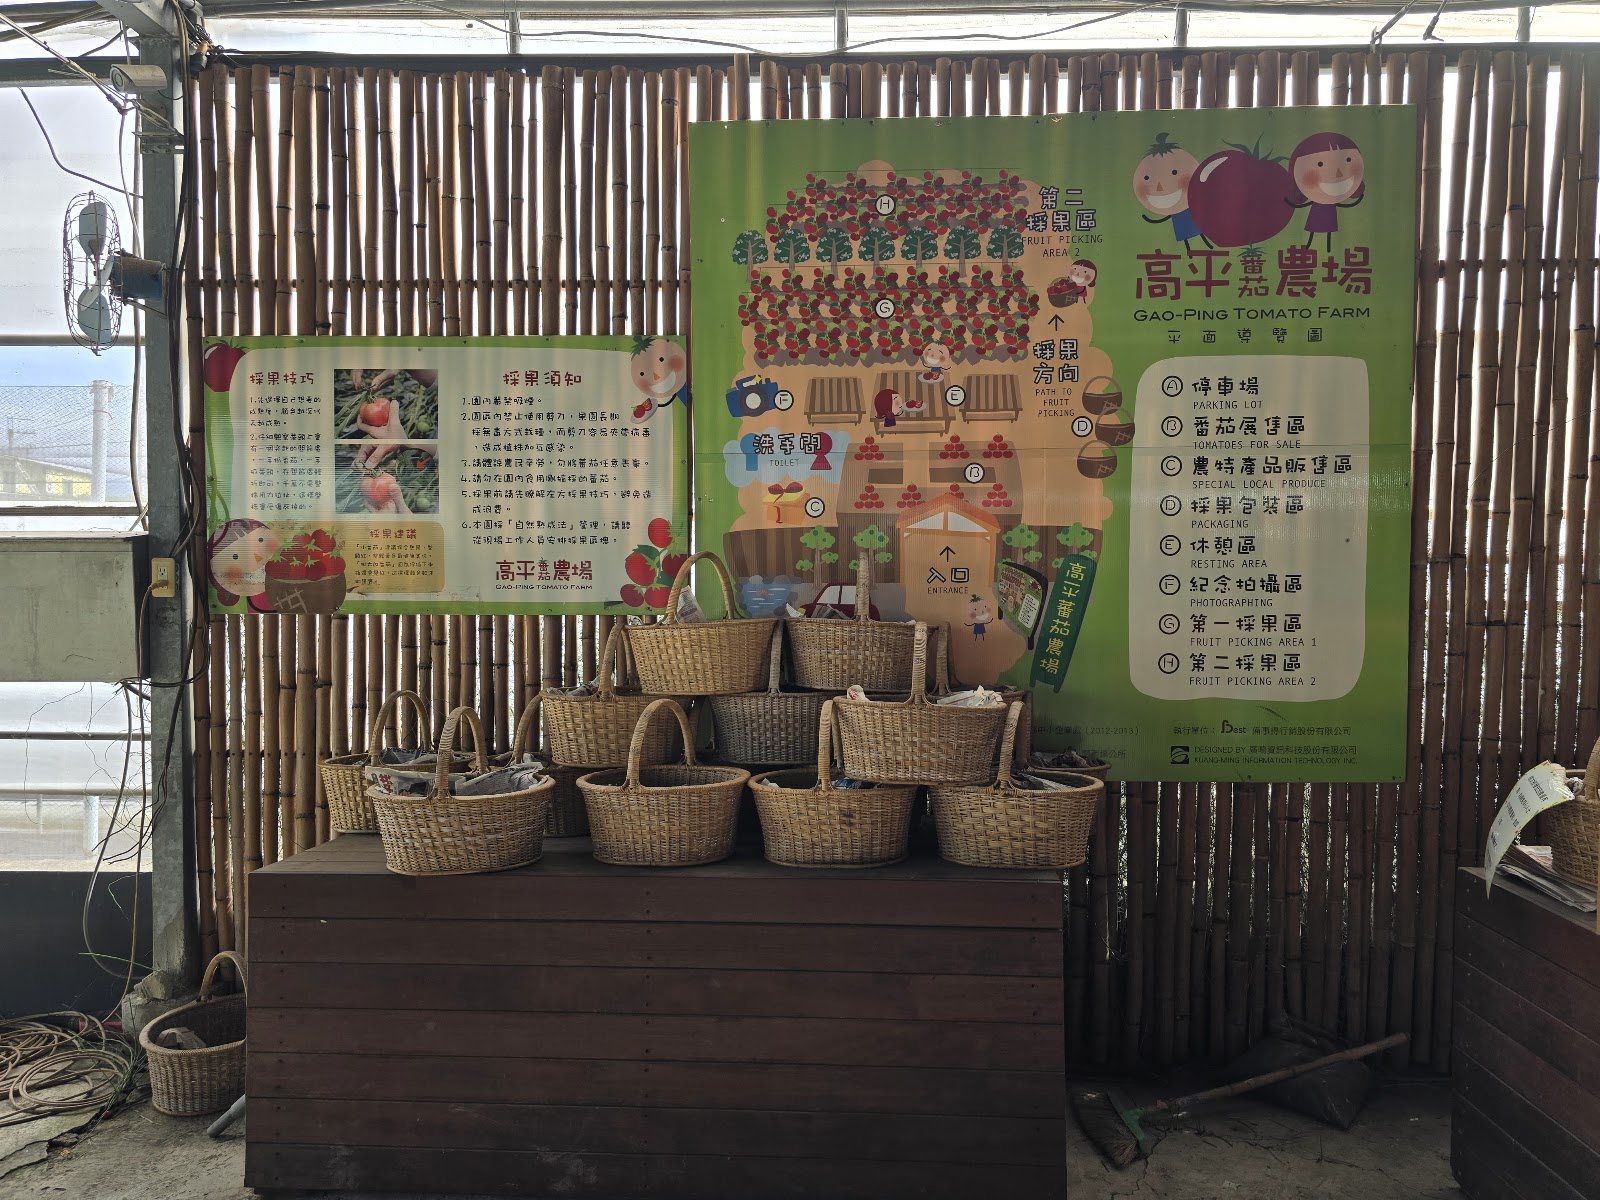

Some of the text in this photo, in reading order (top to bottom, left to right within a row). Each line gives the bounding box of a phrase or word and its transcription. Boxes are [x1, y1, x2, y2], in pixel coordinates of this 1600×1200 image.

[1039, 186, 1083, 209] 第二
[1026, 209, 1096, 232] 採果區
[1022, 235, 1103, 245] FRUIT PICKING
[1043, 248, 1080, 257] AREA 2
[1133, 306, 1371, 322] GAO-PING TOMATO FARM
[1168, 327, 1323, 344] 平面導覽圖
[1033, 339, 1078, 360] 採果
[250, 372, 314, 385] 採果技巧
[503, 370, 582, 387] 採果須知
[1033, 362, 1079, 384] 方向
[1035, 388, 1056, 396] PATH
[1191, 376, 1259, 396] 停車場
[1043, 398, 1069, 406] FRUIT
[1193, 399, 1263, 410] PARKING LOT
[1038, 409, 1075, 417] PICKING
[1193, 416, 1305, 437] 番茄展售區
[753, 433, 821, 455] 洗手間
[1193, 439, 1301, 450] TOMATOES FOR SALE
[770, 458, 799, 467] TOILET
[1192, 455, 1352, 476] 農特產品販售區
[1192, 479, 1326, 489] SPECIAL LOCAL PRODUCE
[1190, 495, 1304, 515] 採果包裝區
[1191, 520, 1249, 529] PACKAGING
[1190, 535, 1256, 555] 休憩區
[1190, 559, 1268, 569] RESTING AREA
[927, 566, 970, 584] 入口
[927, 586, 969, 595] ENTRANCE
[1190, 574, 1302, 594] 紀念拍攝區
[1190, 598, 1273, 608] PHOTOGRAPHING
[1190, 613, 1302, 633] 第一採果區
[1190, 637, 1317, 647] FRUIT PICKING AREA 1
[1189, 653, 1301, 672] 第二採果區
[1189, 677, 1316, 686] FRUIT PICKING AREA 2
[1194, 756, 1240, 764] KUANG-MING
[1242, 756, 1292, 764] INFORMATION
